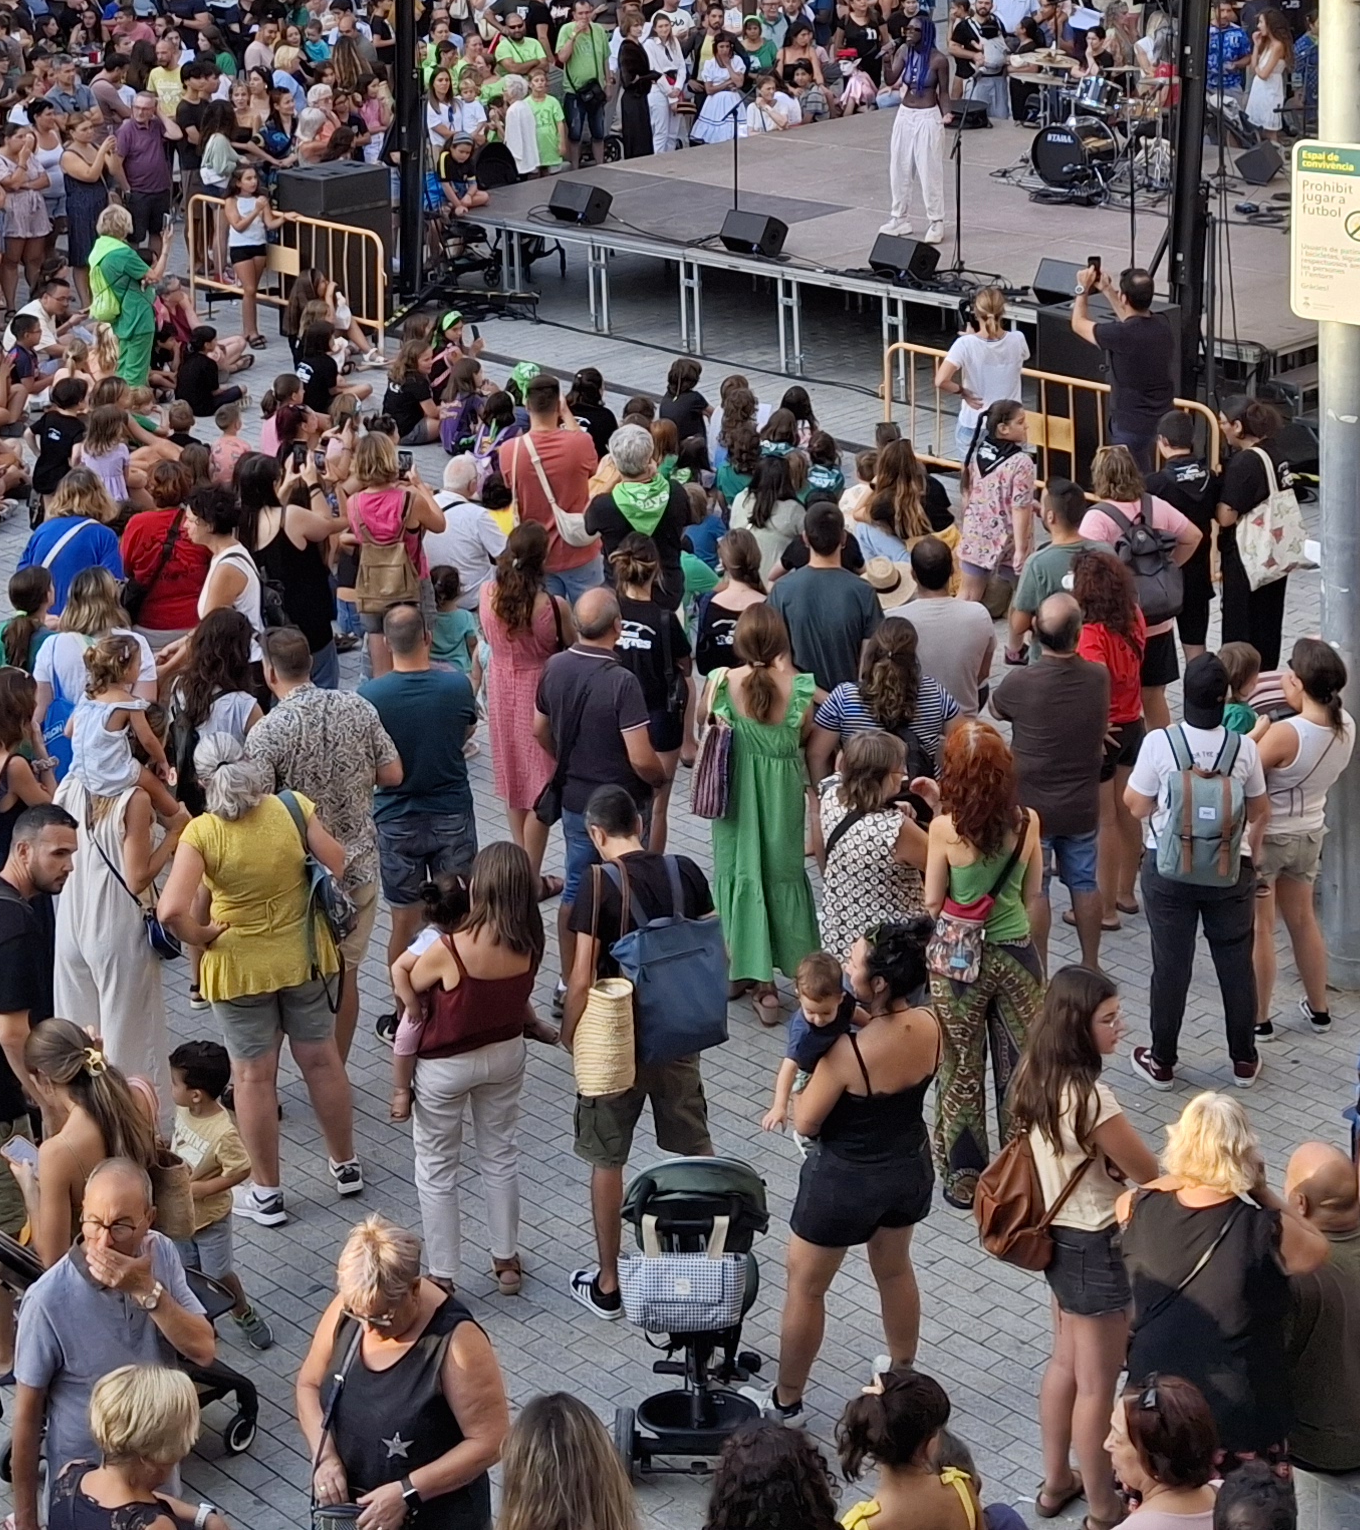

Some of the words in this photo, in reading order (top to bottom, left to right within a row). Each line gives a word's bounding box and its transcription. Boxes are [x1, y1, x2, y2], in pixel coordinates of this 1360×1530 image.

[1302, 150, 1325, 161] Espai
[1327, 152, 1340, 161] de
[1302, 180, 1353, 194] Prohibit
[1302, 192, 1336, 205] jugar
[1338, 196, 1346, 204] a
[1302, 204, 1342, 218] futbol
